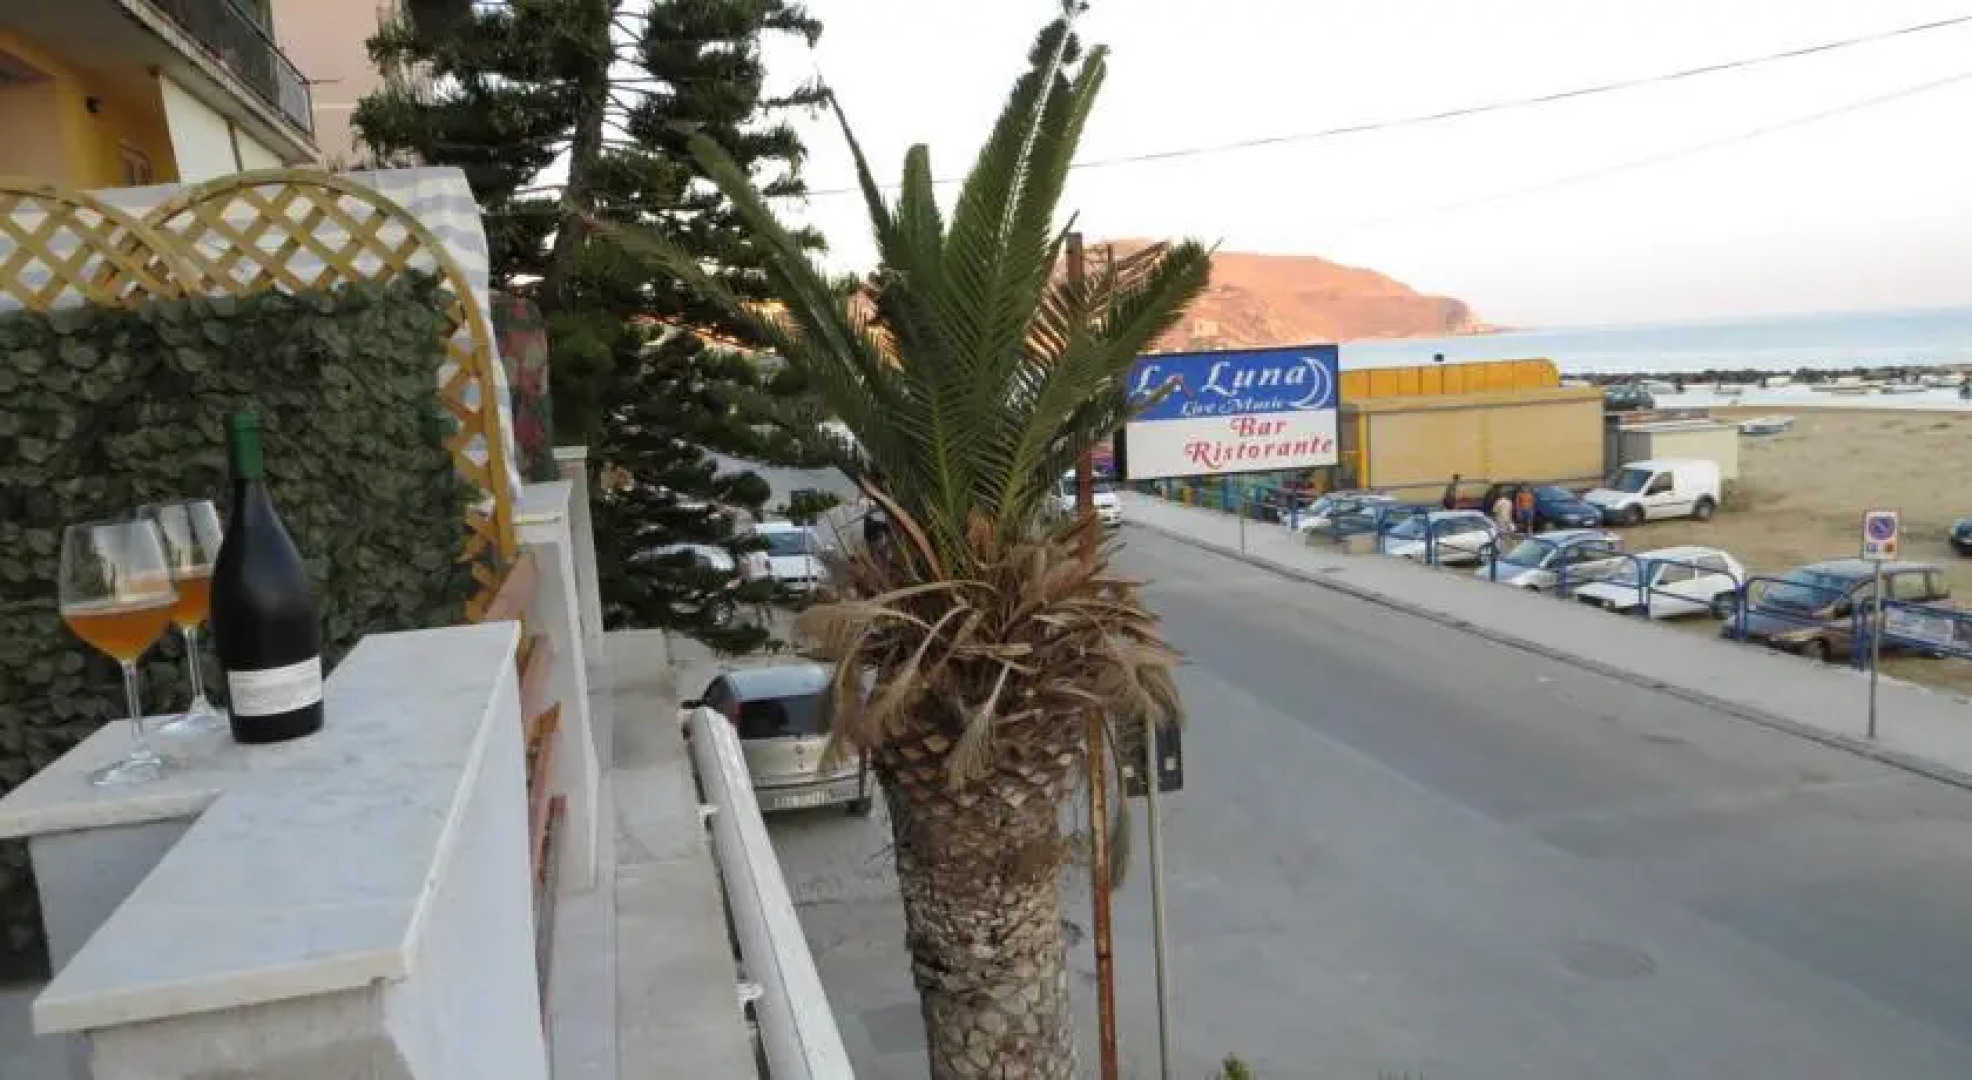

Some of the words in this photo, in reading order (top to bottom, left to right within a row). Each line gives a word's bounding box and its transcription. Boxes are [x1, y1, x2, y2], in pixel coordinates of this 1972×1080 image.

[1130, 365, 1186, 403] L
[1201, 361, 1307, 397] Luna
[1217, 398, 1283, 414] Music
[1229, 417, 1287, 437] Bar
[1184, 437, 1334, 469] Ristorante
